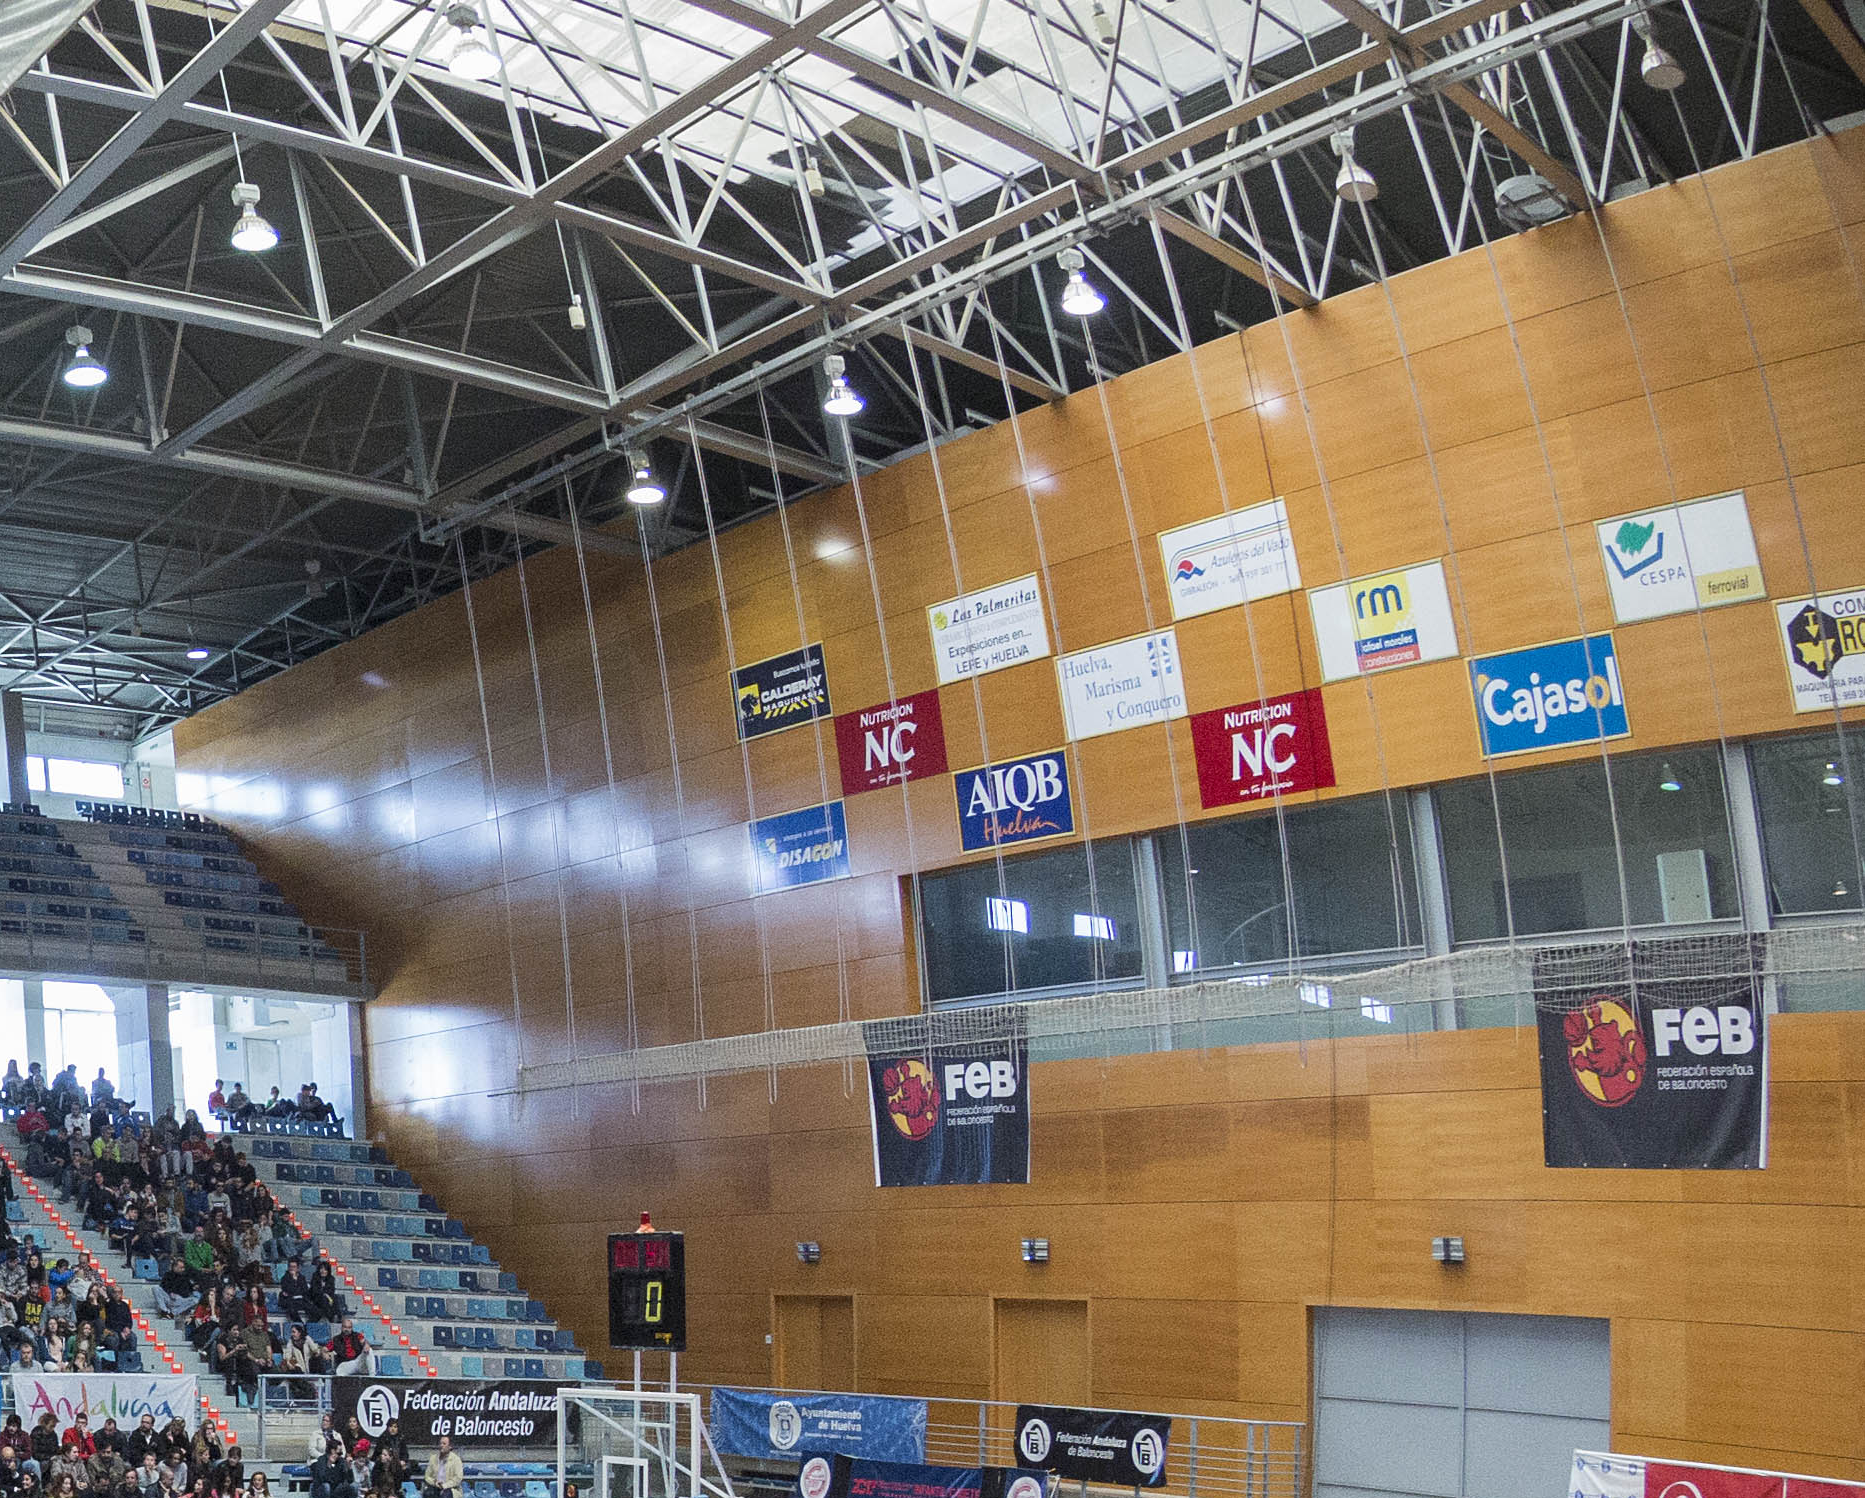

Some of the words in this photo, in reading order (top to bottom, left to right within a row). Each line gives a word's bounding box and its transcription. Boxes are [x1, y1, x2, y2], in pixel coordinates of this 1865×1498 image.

[1640, 566, 1686, 586] CESPA
[1707, 576, 1749, 595] ferrovial
[952, 604, 971, 624] Las
[975, 589, 1037, 617] Palmeritas
[1356, 584, 1403, 619] rm
[949, 632, 1006, 660] Exposiciones
[1384, 634, 1413, 648] morales
[991, 645, 1029, 666] HUELVA
[1062, 653, 1112, 680] Huelva,
[763, 689, 824, 712] MAQUINARIA
[1085, 674, 1141, 702] Marisma
[1482, 656, 1622, 734] Cajasol
[1117, 695, 1181, 720] Conquero
[864, 721, 917, 771] NC
[1231, 723, 1297, 781] NC
[966, 758, 1063, 817] AIQB
[983, 810, 1062, 841] Huelva
[779, 842, 843, 869] DISAGON
[646, 1282, 662, 1322] 0
[28, 1378, 176, 1421] Andalucía
[404, 1389, 486, 1412] Federación
[490, 1386, 560, 1412] Andaluza
[430, 1416, 448, 1436] de
[451, 1415, 534, 1437] Baloncesto
[802, 1408, 862, 1421] Ayuntamiento
[818, 1419, 828, 1431] de
[830, 1419, 862, 1432] Huelva
[1056, 1432, 1091, 1447] Federación
[1093, 1435, 1127, 1449] Andaluza
[1068, 1445, 1078, 1455] de
[1079, 1446, 1114, 1458] Baloncesto
